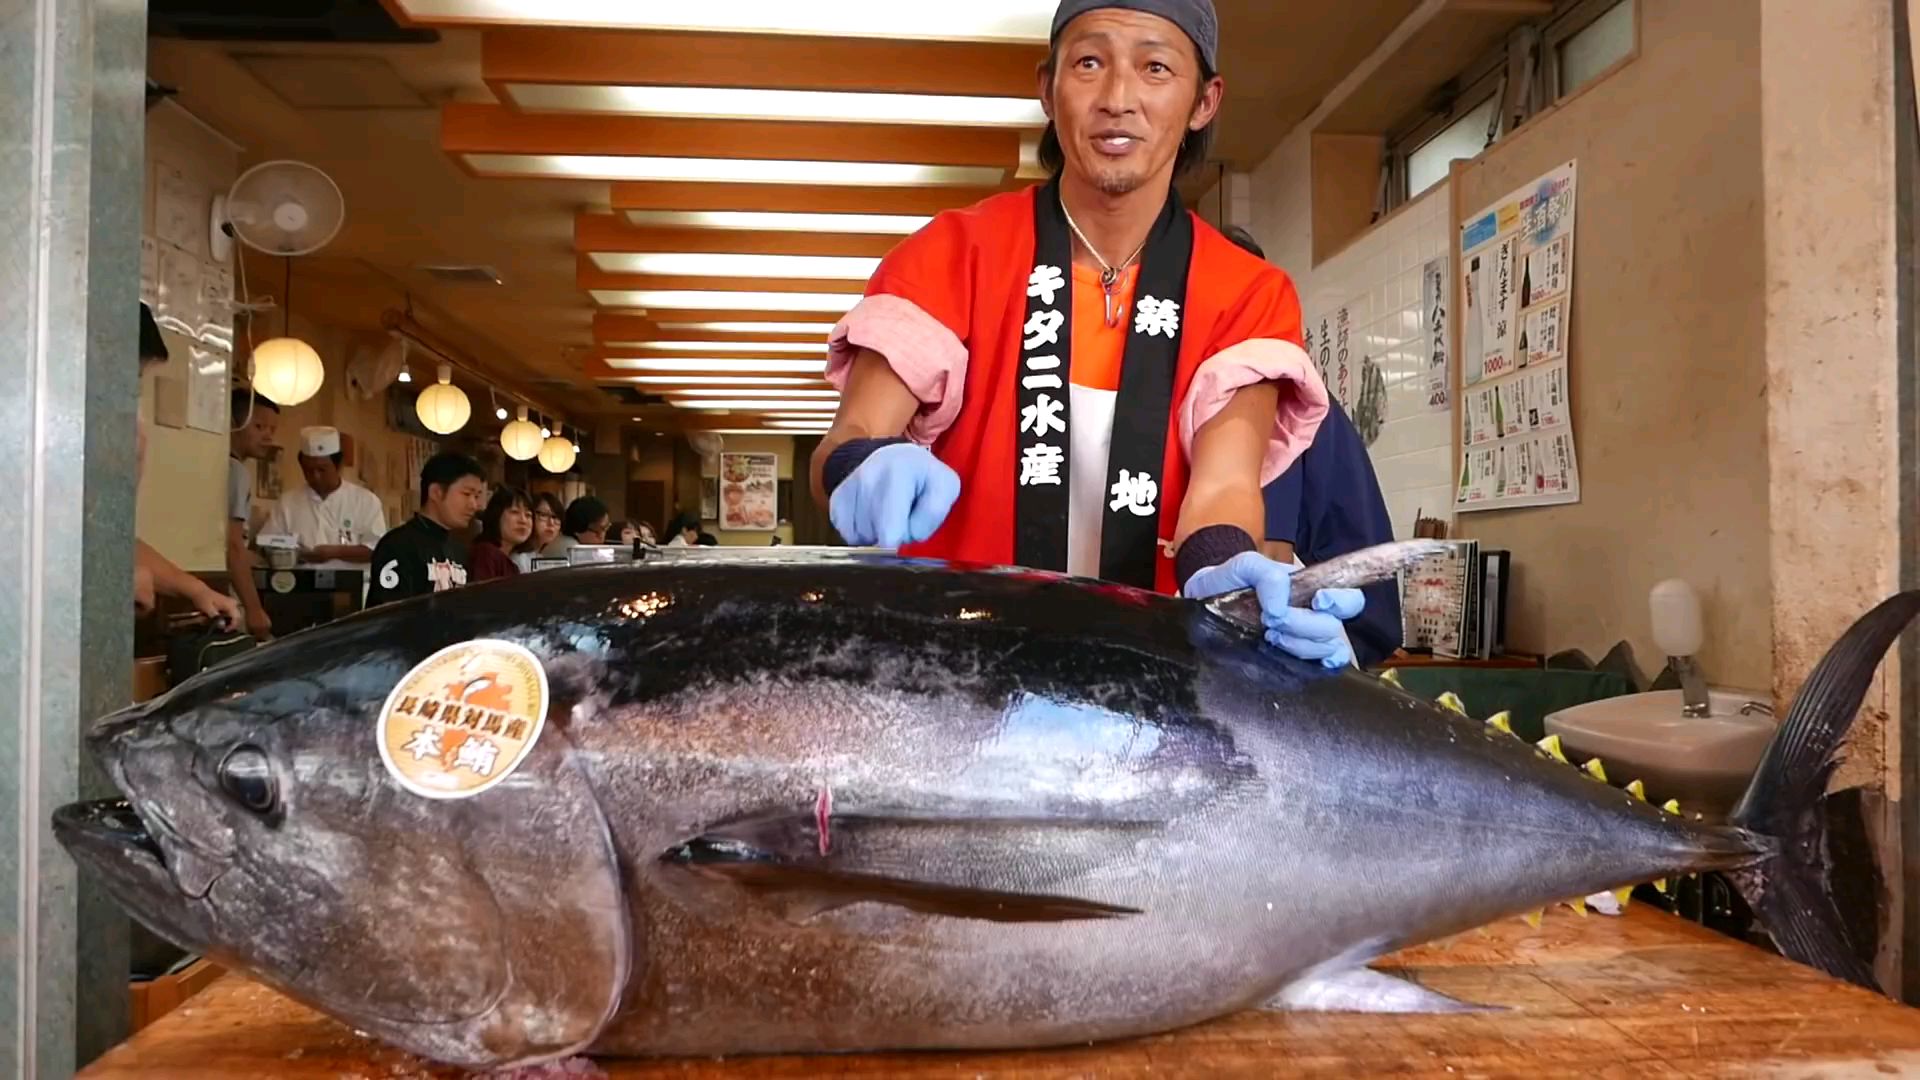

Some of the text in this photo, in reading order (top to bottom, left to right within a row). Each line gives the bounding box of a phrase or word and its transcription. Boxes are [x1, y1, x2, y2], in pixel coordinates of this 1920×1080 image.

[1019, 264, 1066, 487] キタニ水産
[379, 559, 400, 589] 6
[394, 694, 529, 742] 長崎県対馬産
